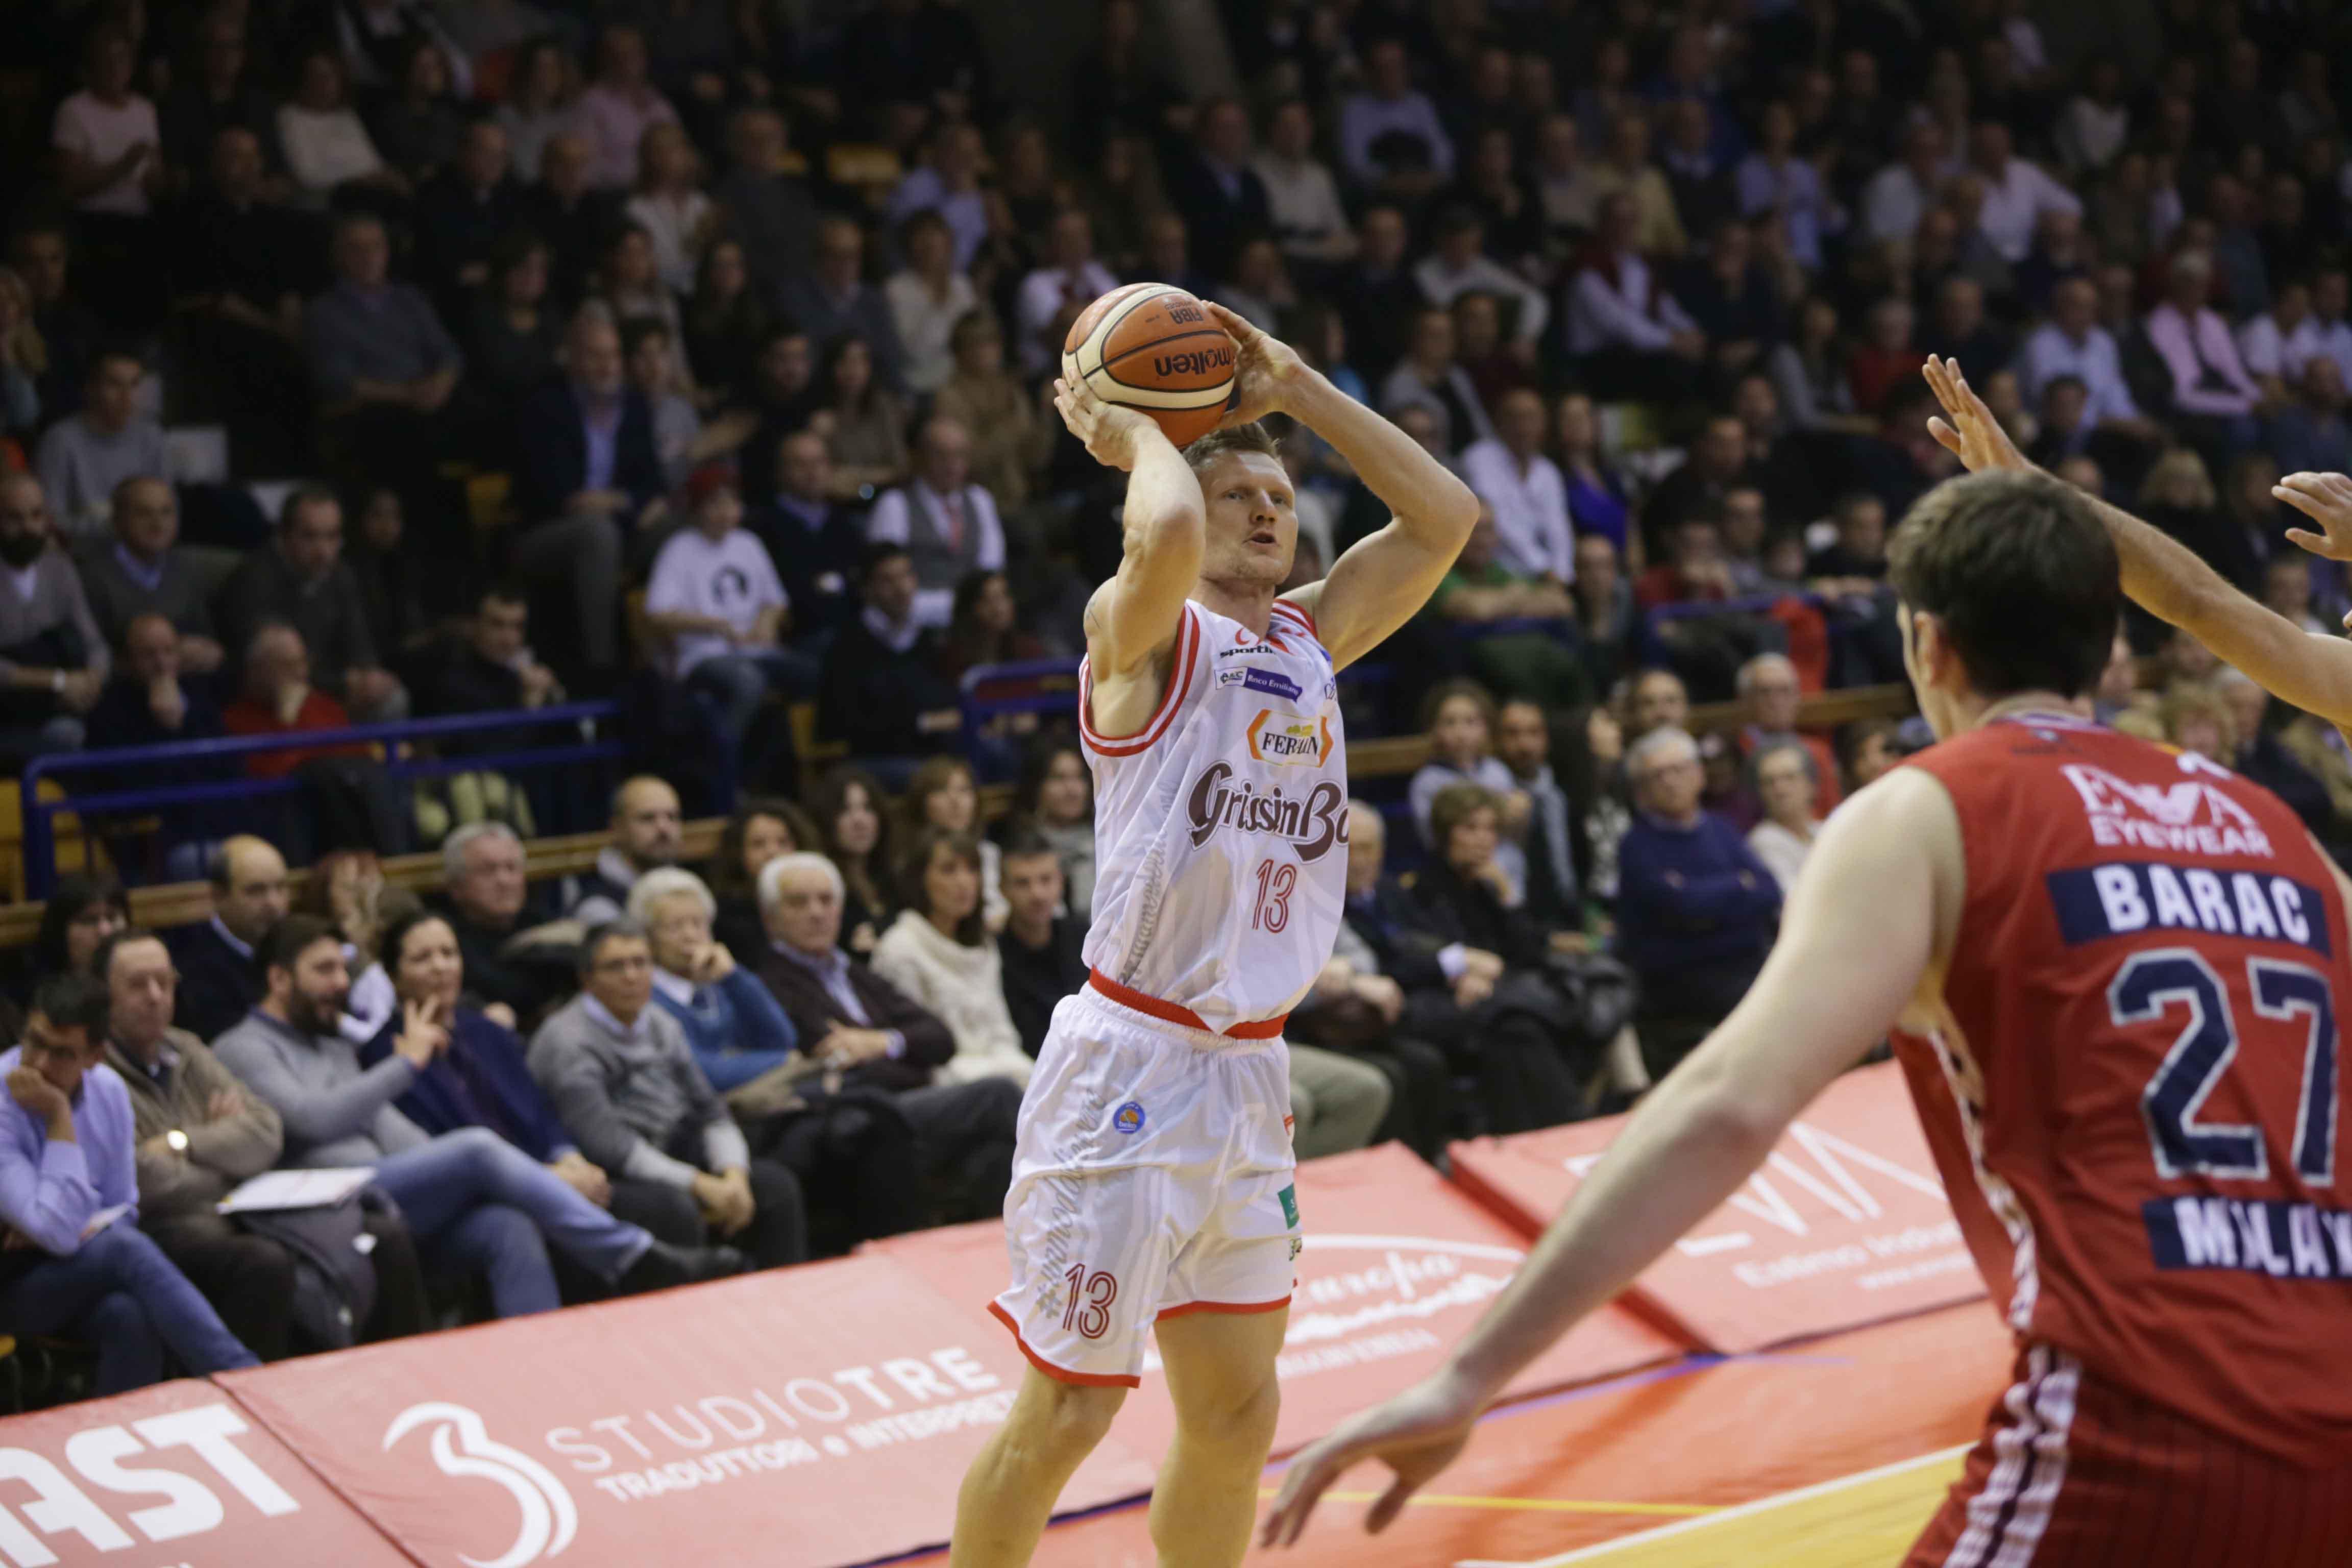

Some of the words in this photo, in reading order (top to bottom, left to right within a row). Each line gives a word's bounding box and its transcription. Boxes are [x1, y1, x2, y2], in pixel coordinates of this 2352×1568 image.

[1168, 307, 1204, 325] FIBA
[1154, 347, 1233, 377] molten
[1253, 859, 1297, 934] 13
[2092, 864, 2311, 944] BARAC
[2106, 947, 2339, 1188] 27
[1063, 1263, 1117, 1339] 13
[546, 1346, 1000, 1472] STUDIOTRE
[846, 1390, 1019, 1451] INTERPRET
[0, 1404, 301, 1568] AST
